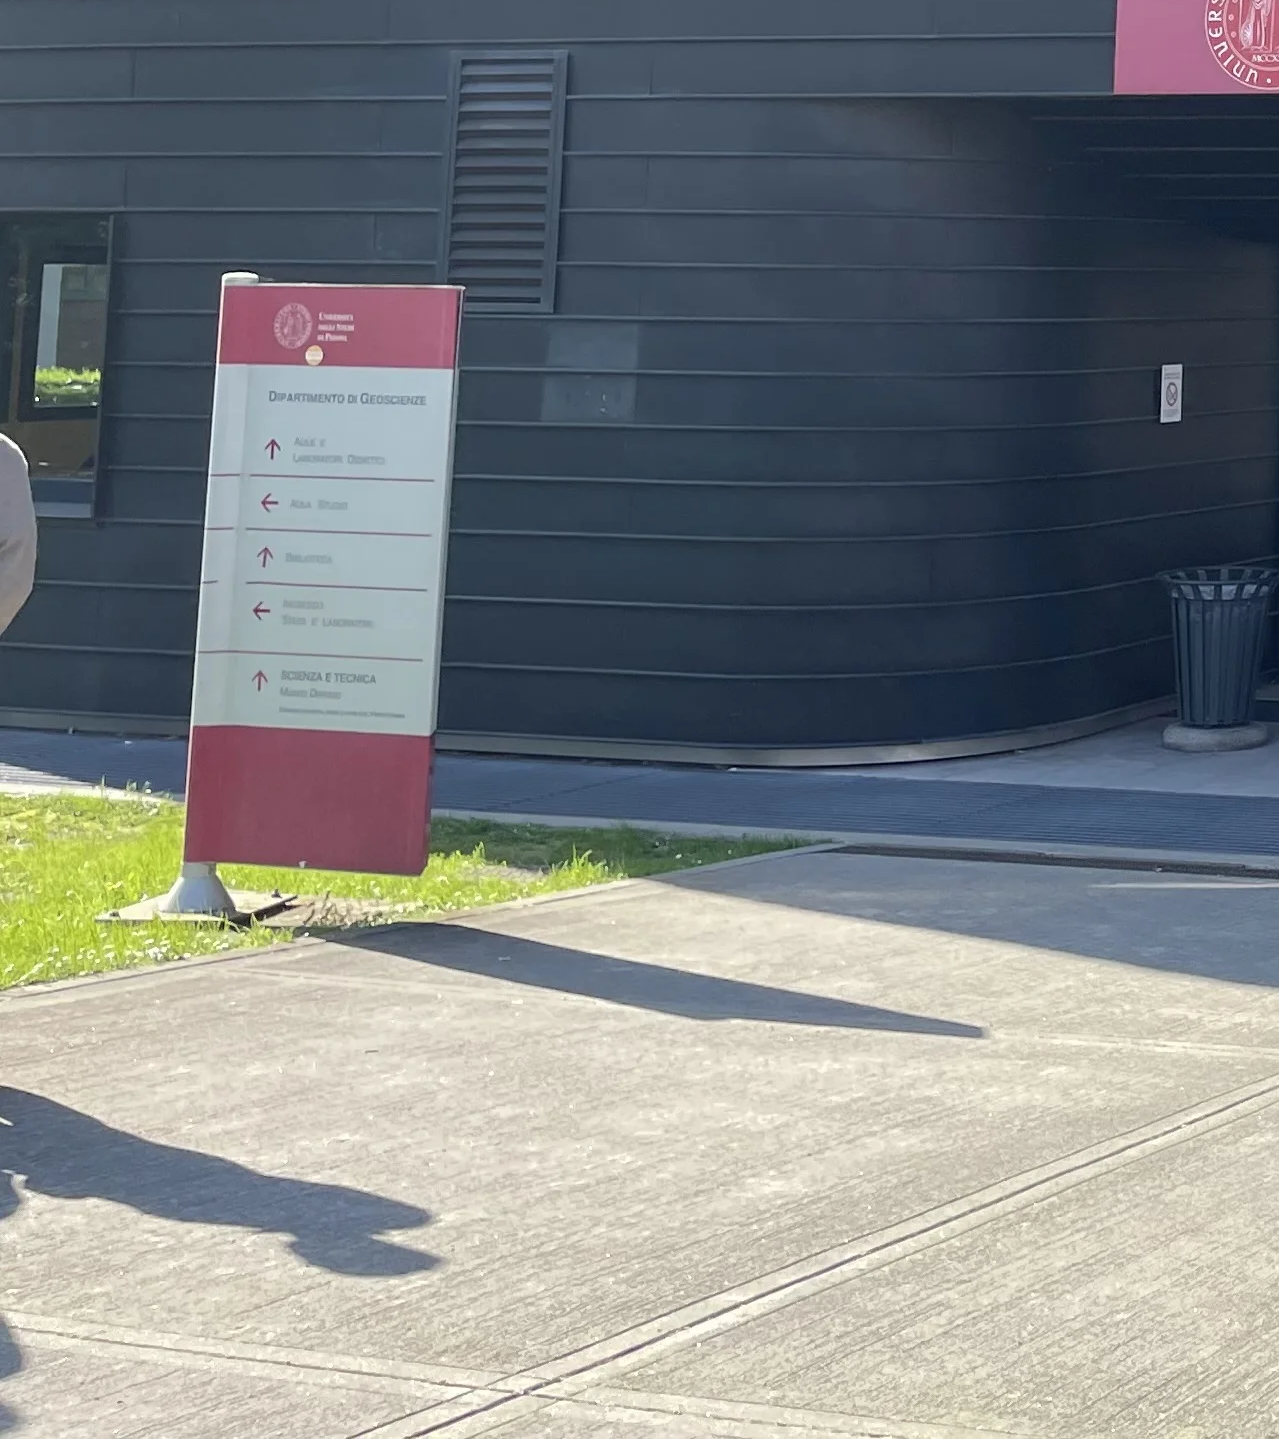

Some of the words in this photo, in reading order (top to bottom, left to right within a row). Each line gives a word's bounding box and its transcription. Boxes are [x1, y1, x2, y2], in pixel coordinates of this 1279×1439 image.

[268, 390, 345, 404] DIPARTIMENTO
[347, 393, 358, 404] DI
[360, 392, 427, 406] GEOSCIENZE
[280, 669, 323, 682] SCIENZA
[325, 671, 333, 683] E
[334, 672, 377, 685] TECNICA
